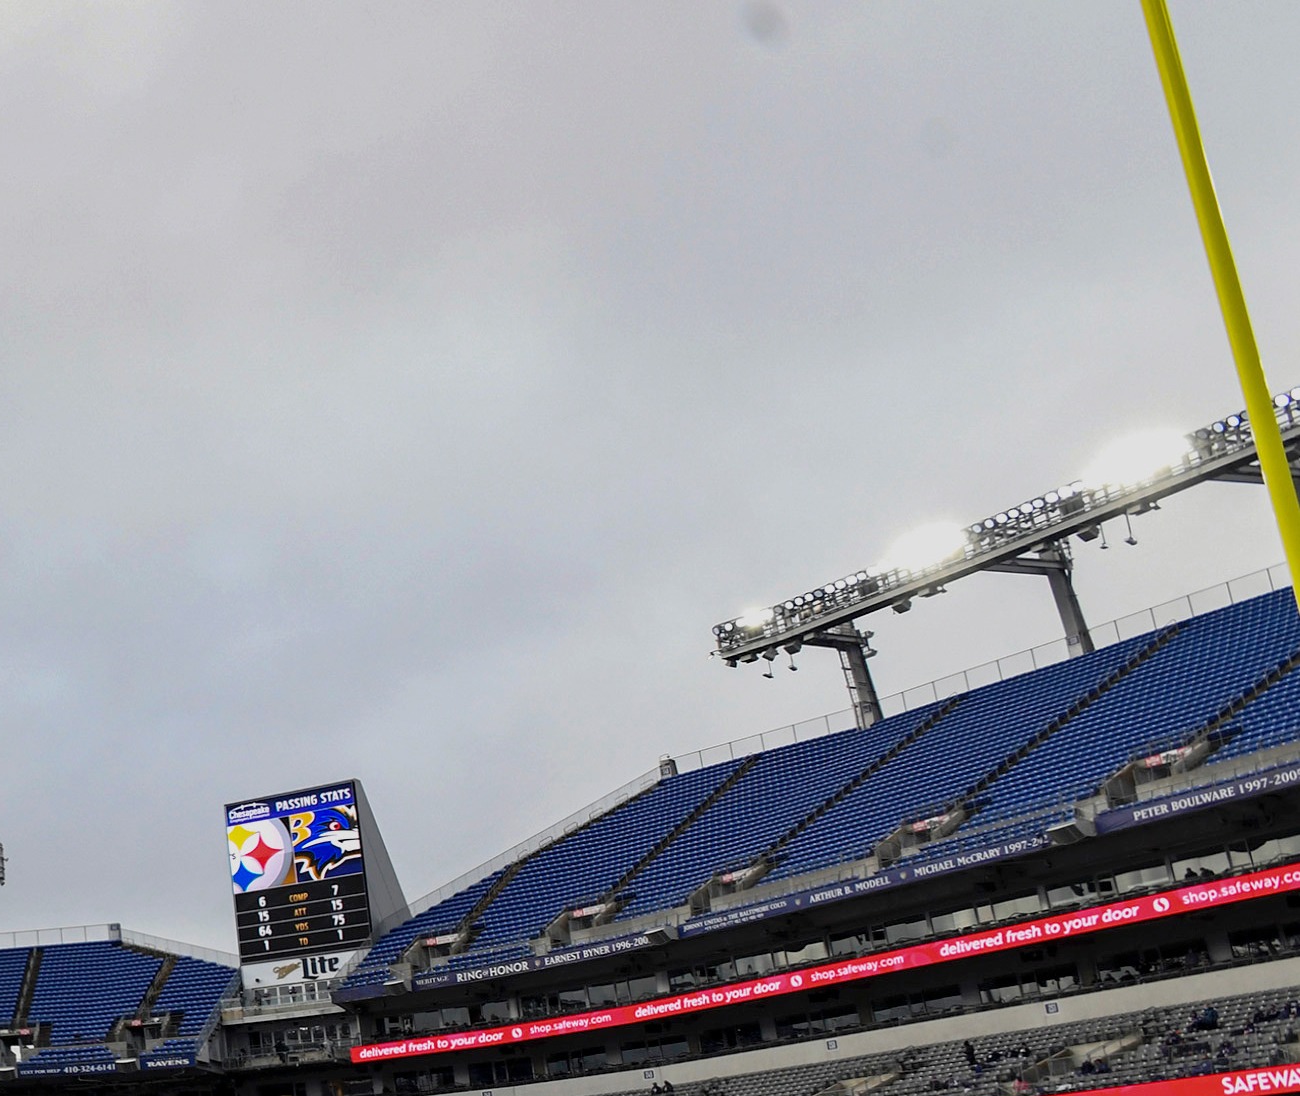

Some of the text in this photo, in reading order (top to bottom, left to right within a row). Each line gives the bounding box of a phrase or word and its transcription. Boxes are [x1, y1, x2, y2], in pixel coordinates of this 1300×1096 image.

[275, 787, 351, 812] PASSING STATS
[1133, 803, 1169, 821] PETER
[1171, 786, 1235, 811] BOULWARE
[914, 847, 1000, 877] MICHAEL McCRARY
[258, 885, 339, 907] 6 COMP 7
[809, 887, 844, 904] ARTHUR
[855, 876, 892, 892] MODELL
[258, 911, 269, 922] 15
[331, 900, 343, 911] 15
[941, 870, 1300, 957] delivered fresh to your door shop.safeway.co
[258, 926, 272, 937] 64
[332, 914, 345, 926] 75
[263, 929, 344, 951] 1 TD 1
[545, 951, 581, 966] EARNEST
[583, 945, 611, 960] BYNER
[301, 956, 340, 979] Lite
[456, 960, 529, 983] RING HONOR
[635, 954, 905, 1019] delivered fresh to your door shop.safeway.com
[359, 1013, 612, 1060] delivered fresh to your door shop.safeway.com
[63, 1063, 116, 1075] 410-324-6141
[146, 1057, 190, 1068] RAVENS
[1222, 1067, 1300, 1096] SAFEWA
